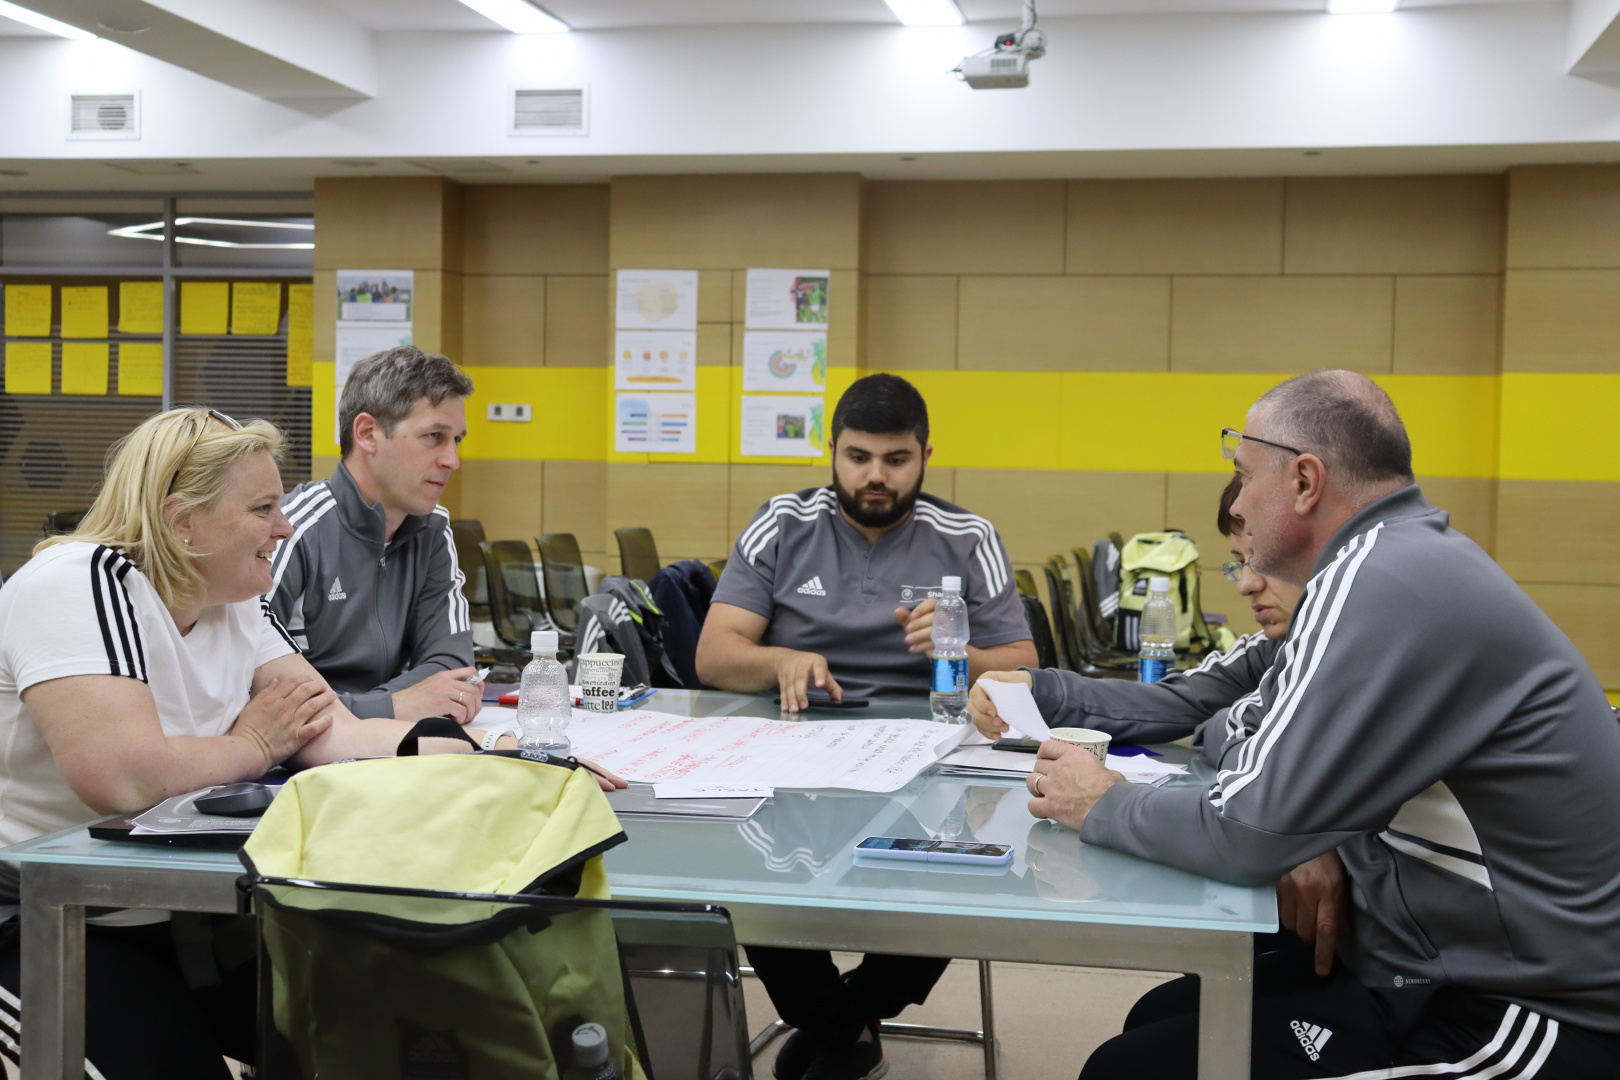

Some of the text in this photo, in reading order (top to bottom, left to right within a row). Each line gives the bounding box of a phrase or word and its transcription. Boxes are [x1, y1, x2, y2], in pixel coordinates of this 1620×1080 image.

[797, 586, 826, 597] adidas
[601, 699, 614, 710] tea
[1289, 1019, 1320, 1062] adidas
